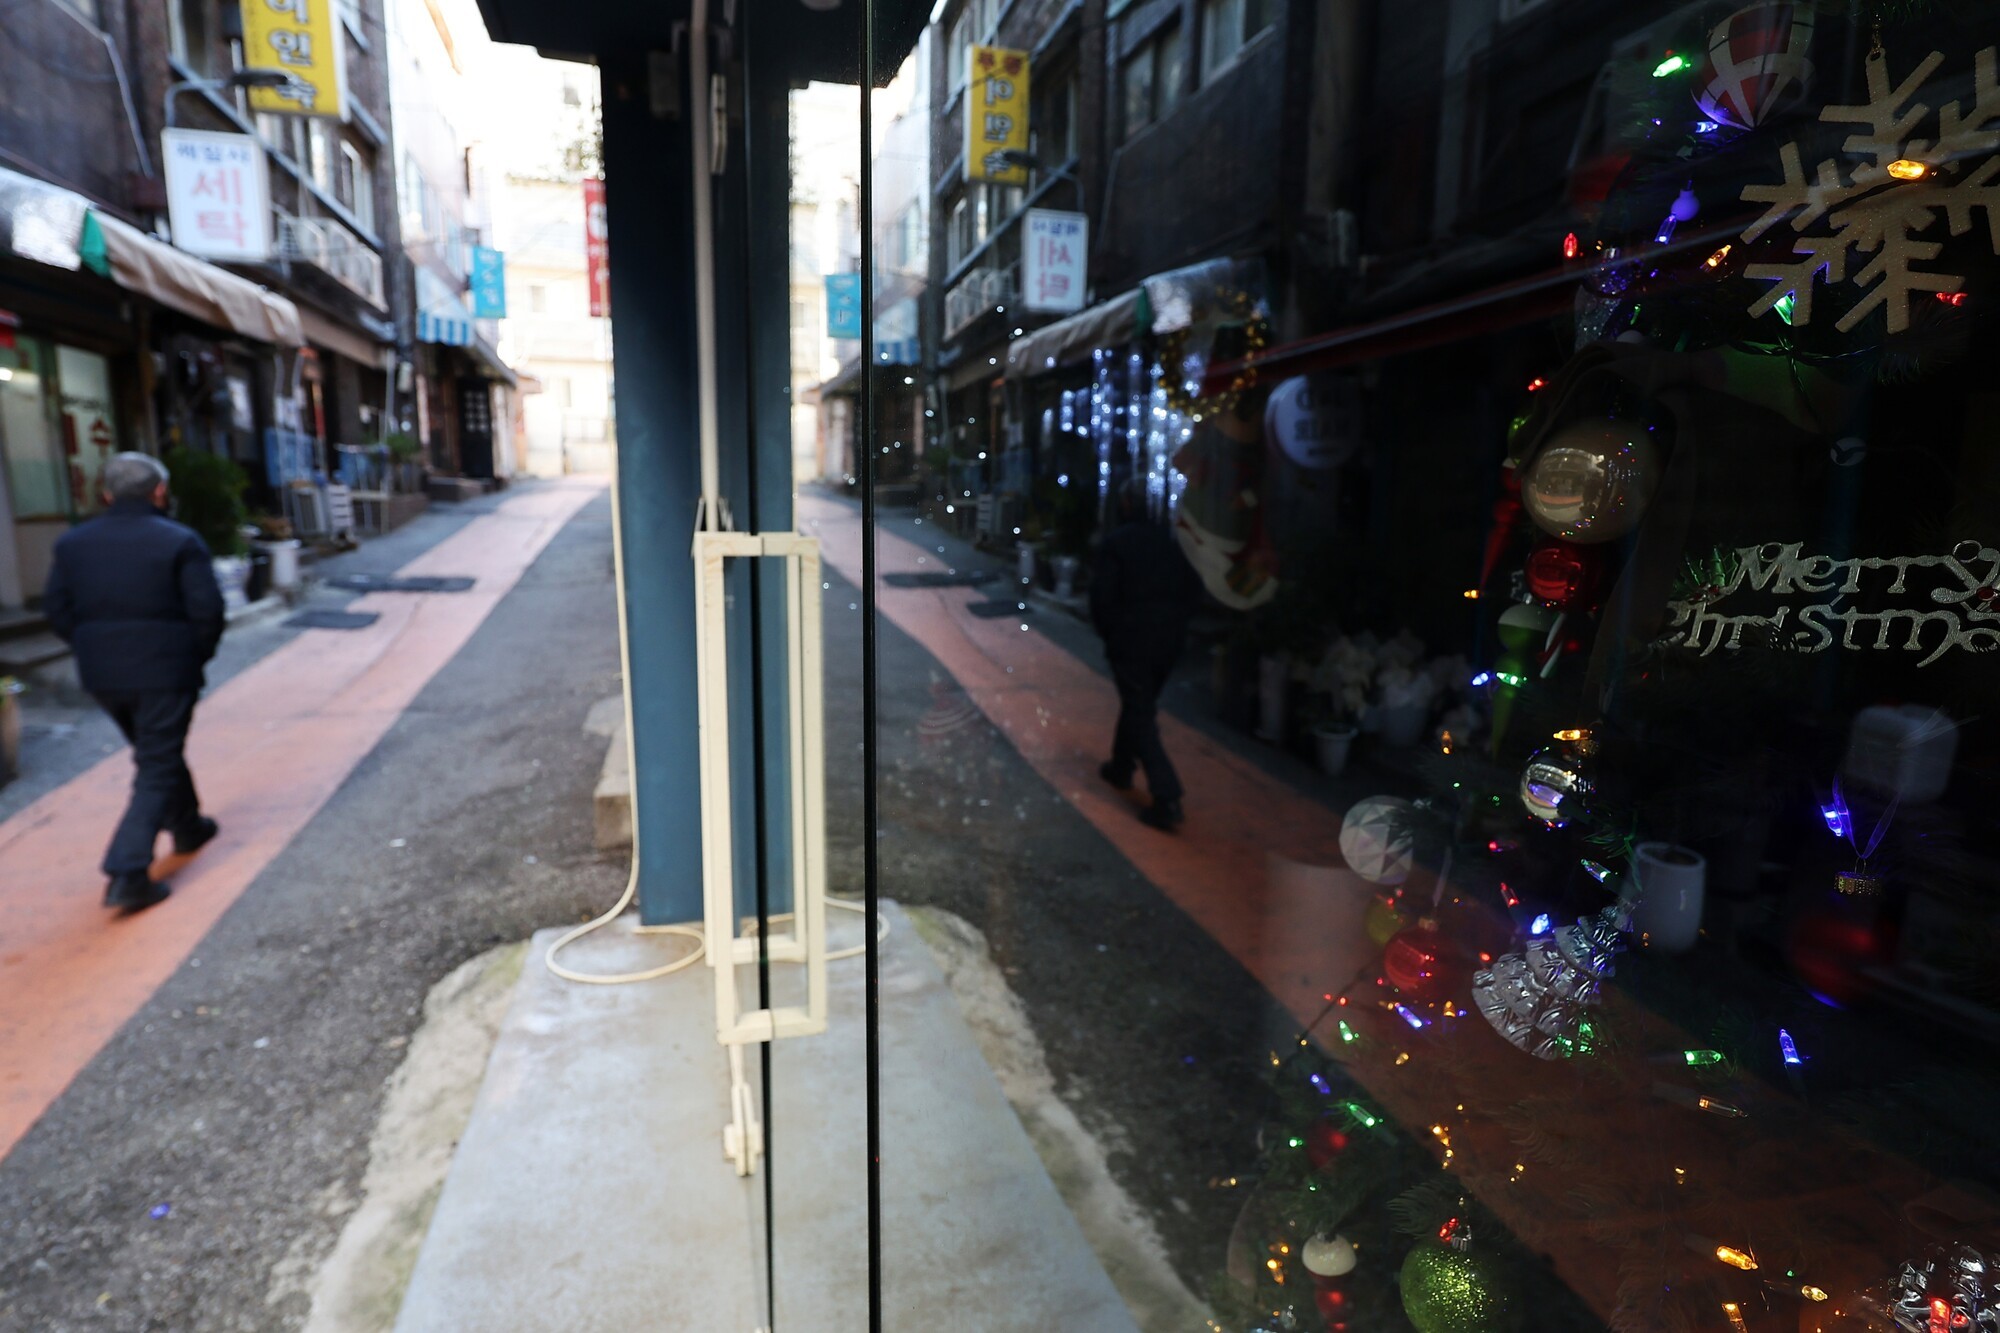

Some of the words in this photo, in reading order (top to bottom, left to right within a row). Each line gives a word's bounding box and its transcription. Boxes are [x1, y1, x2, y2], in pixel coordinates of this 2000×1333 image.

[190, 167, 249, 250] 세탁
[1708, 540, 2000, 605] Merry
[1650, 598, 2000, 668] hristma
